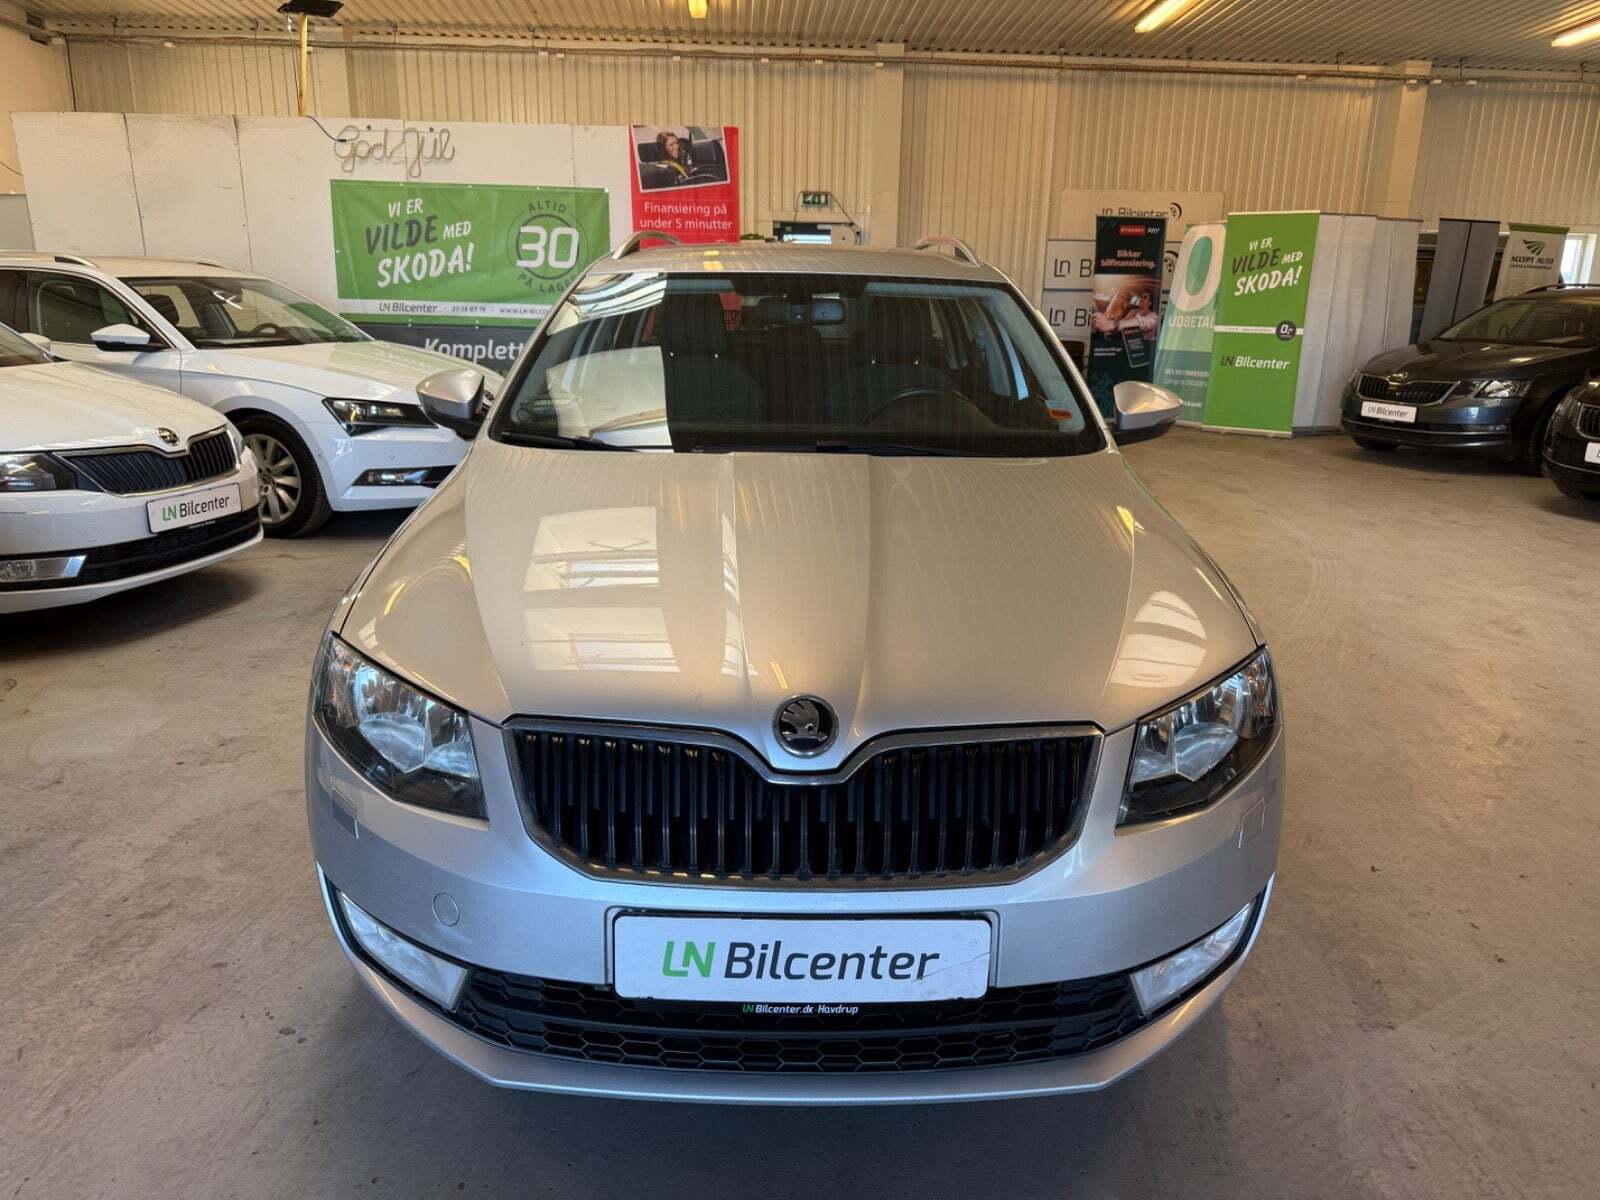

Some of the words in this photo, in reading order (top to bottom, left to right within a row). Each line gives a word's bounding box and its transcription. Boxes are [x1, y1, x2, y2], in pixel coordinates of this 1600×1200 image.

[388, 201, 400, 218] VI
[406, 198, 424, 214] ER
[528, 200, 567, 213] ALTID
[644, 202, 710, 216] Finansiering
[714, 203, 727, 216] på
[640, 219, 672, 229] under
[675, 218, 682, 229] 5
[685, 219, 733, 230] minutter
[366, 215, 439, 255] VILDE
[443, 221, 472, 240] MED
[1249, 241, 1259, 251] VI
[1261, 237, 1273, 248] ER
[516, 225, 580, 269] 30
[377, 242, 475, 288] SKODA!
[1232, 249, 1281, 275] VILDE
[1282, 251, 1303, 264] MED
[1234, 266, 1303, 296] SKODA!
[392, 302, 438, 313] Bilcenter
[1235, 355, 1290, 370] Bilcenter
[162, 505, 177, 521] LN
[180, 496, 230, 518] Bilcenter
[661, 940, 716, 978] LN
[724, 941, 940, 980] Bilcenter
[818, 1004, 859, 1015] Havdrup
